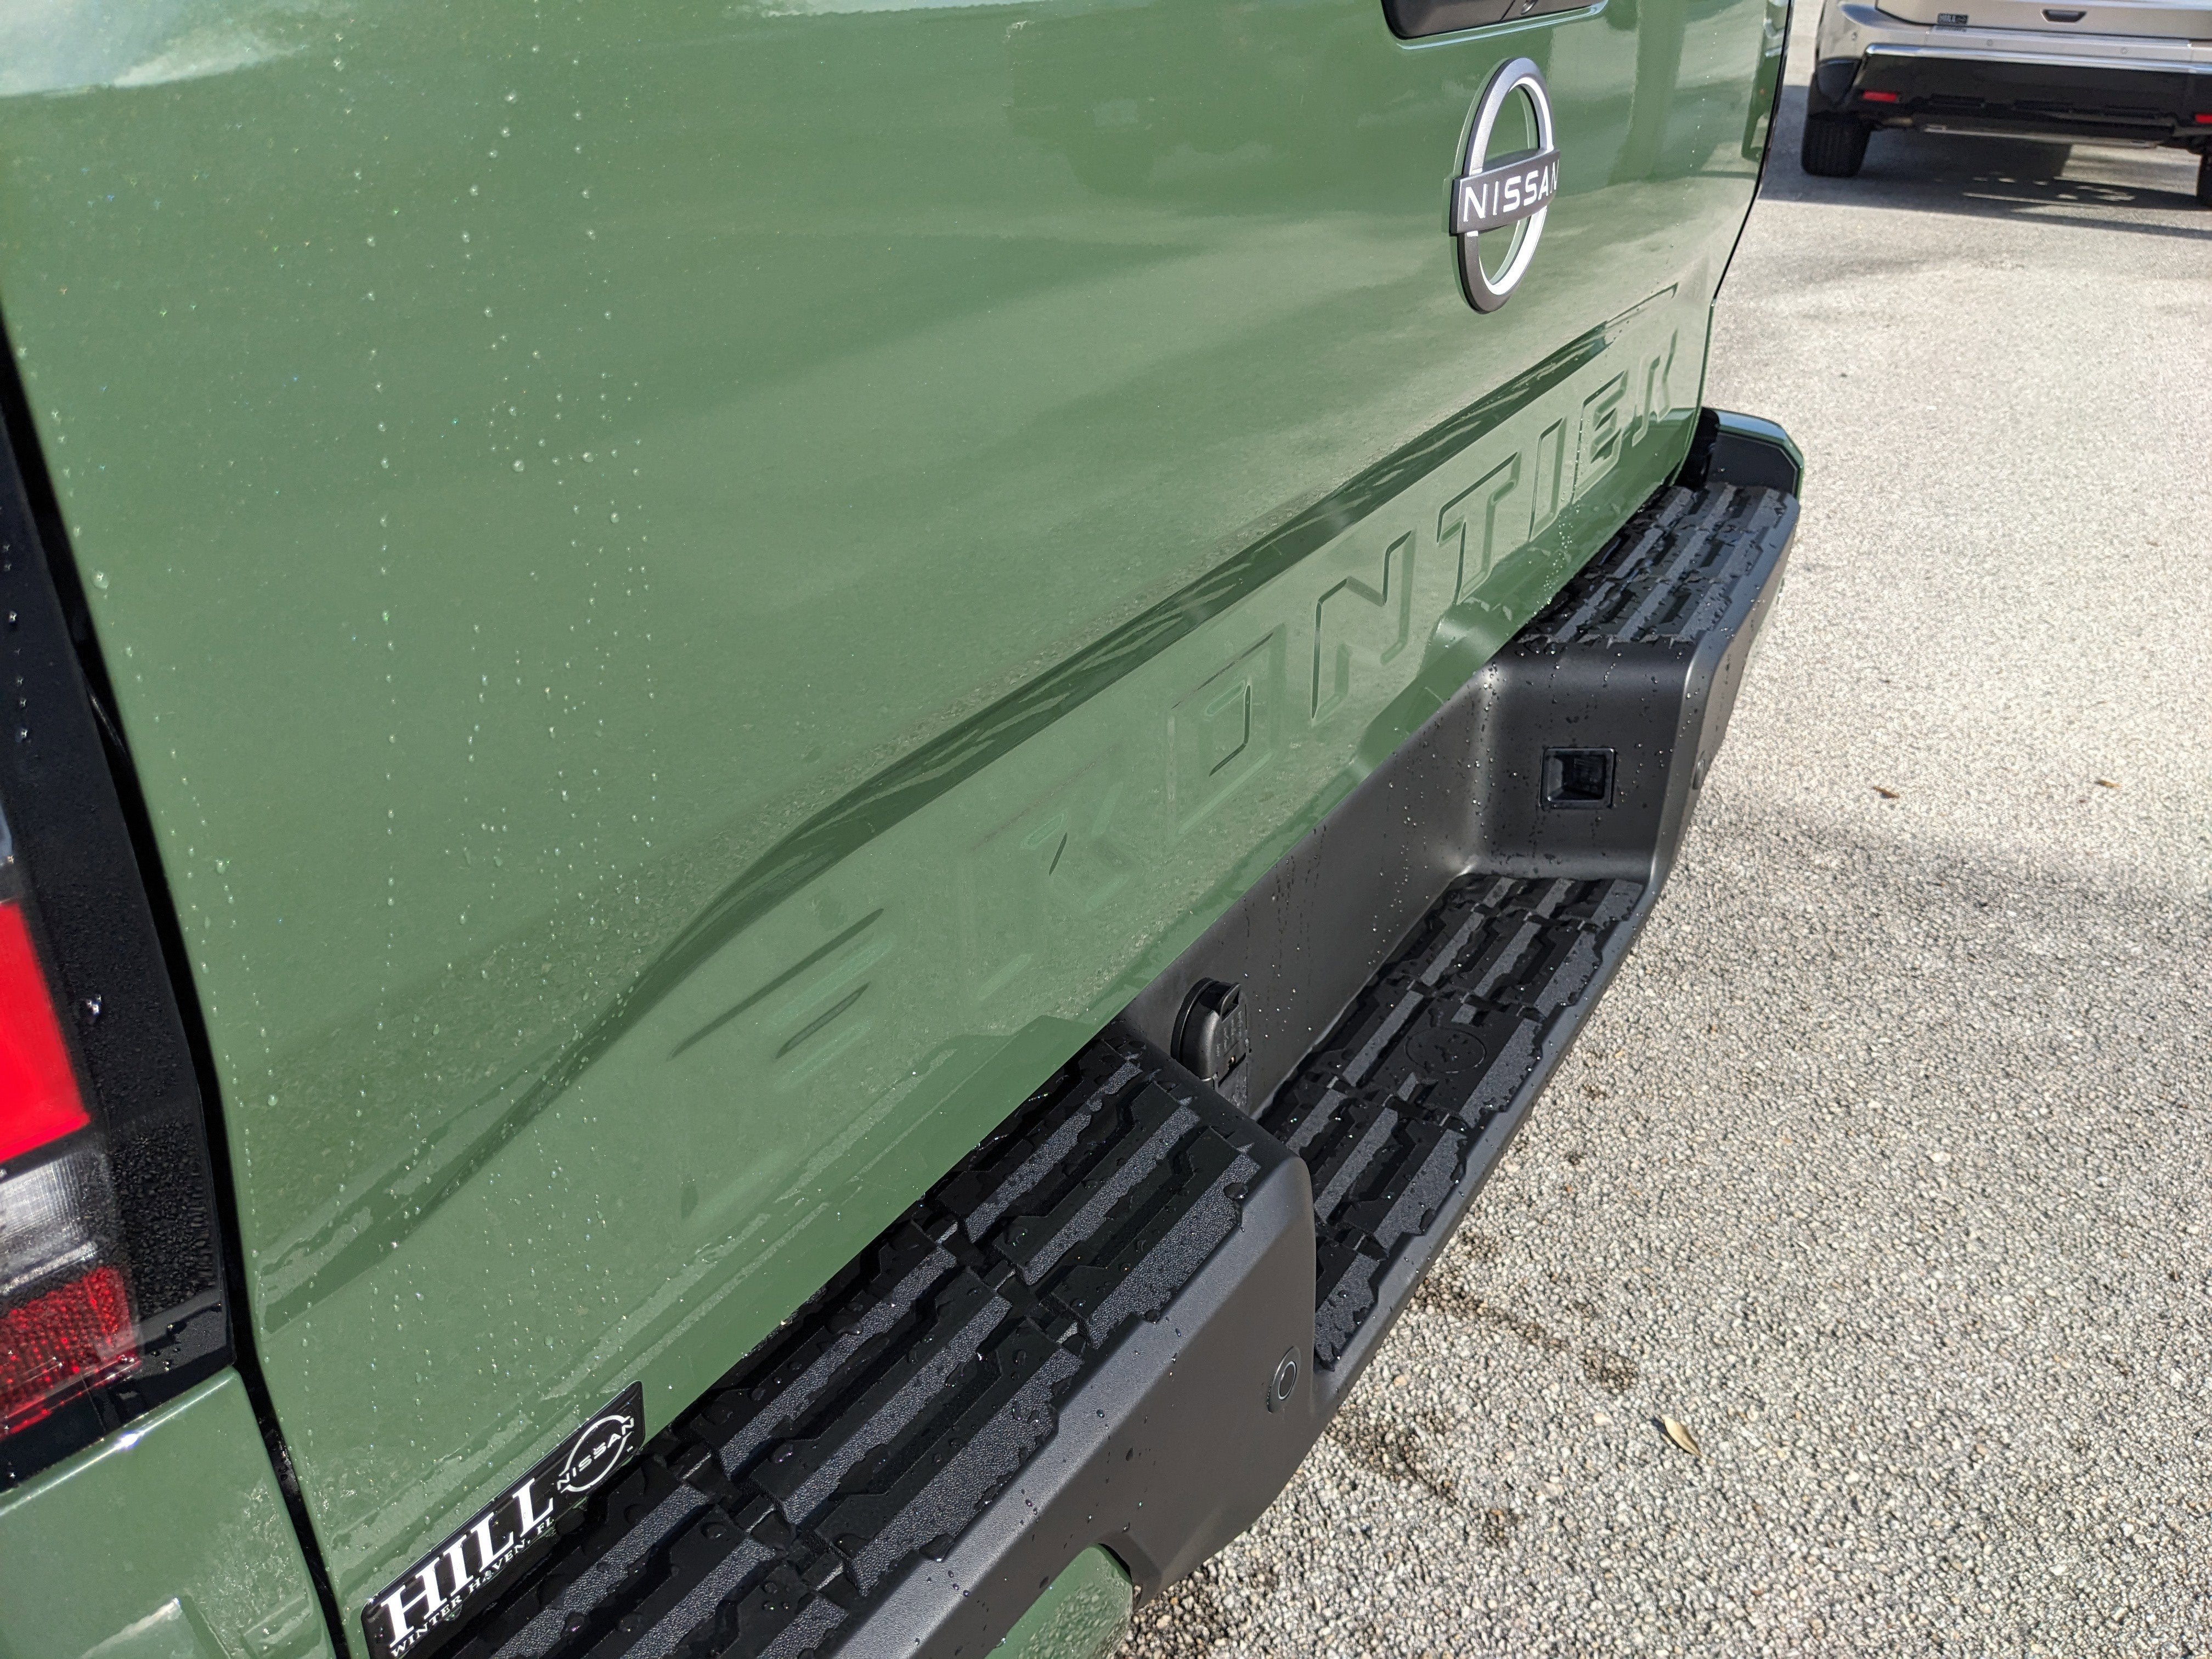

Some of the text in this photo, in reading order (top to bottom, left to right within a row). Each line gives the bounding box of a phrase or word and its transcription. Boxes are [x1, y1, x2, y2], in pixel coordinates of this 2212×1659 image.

[1463, 159, 1560, 222] NISSAN
[557, 1417, 634, 1491] NISSAN
[380, 1477, 554, 1648] HILL
[391, 1594, 462, 1657] WINTER
[536, 1516, 554, 1536] FL
